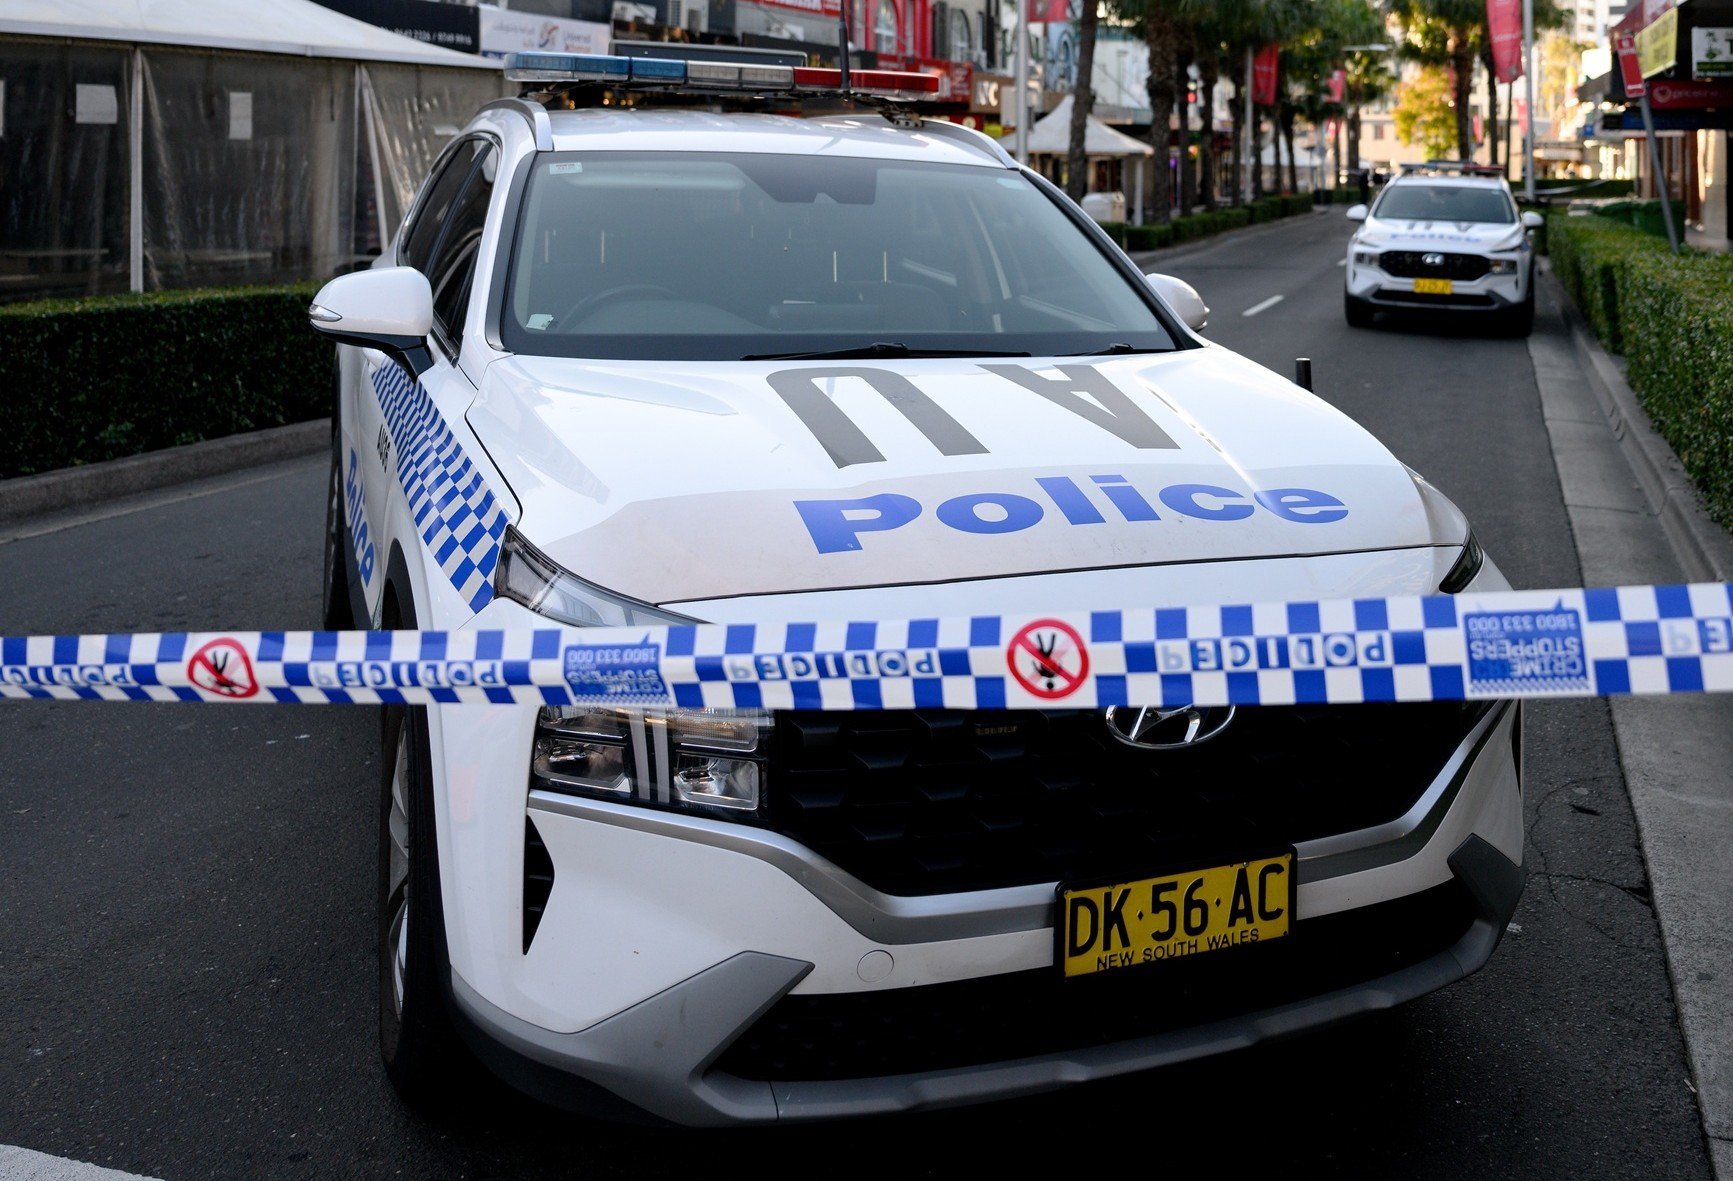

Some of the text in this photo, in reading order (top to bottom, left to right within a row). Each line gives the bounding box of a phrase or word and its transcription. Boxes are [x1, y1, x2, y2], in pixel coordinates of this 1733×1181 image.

[793, 475, 1349, 554] Police
[1196, 632, 1386, 669] POLICE
[1469, 636, 1580, 661] STOPPERS
[341, 661, 499, 687] POLICE
[758, 650, 936, 679] POLICE
[1509, 655, 1583, 677] CRIME
[1096, 928, 1260, 971] NEW SOUTH WALES
